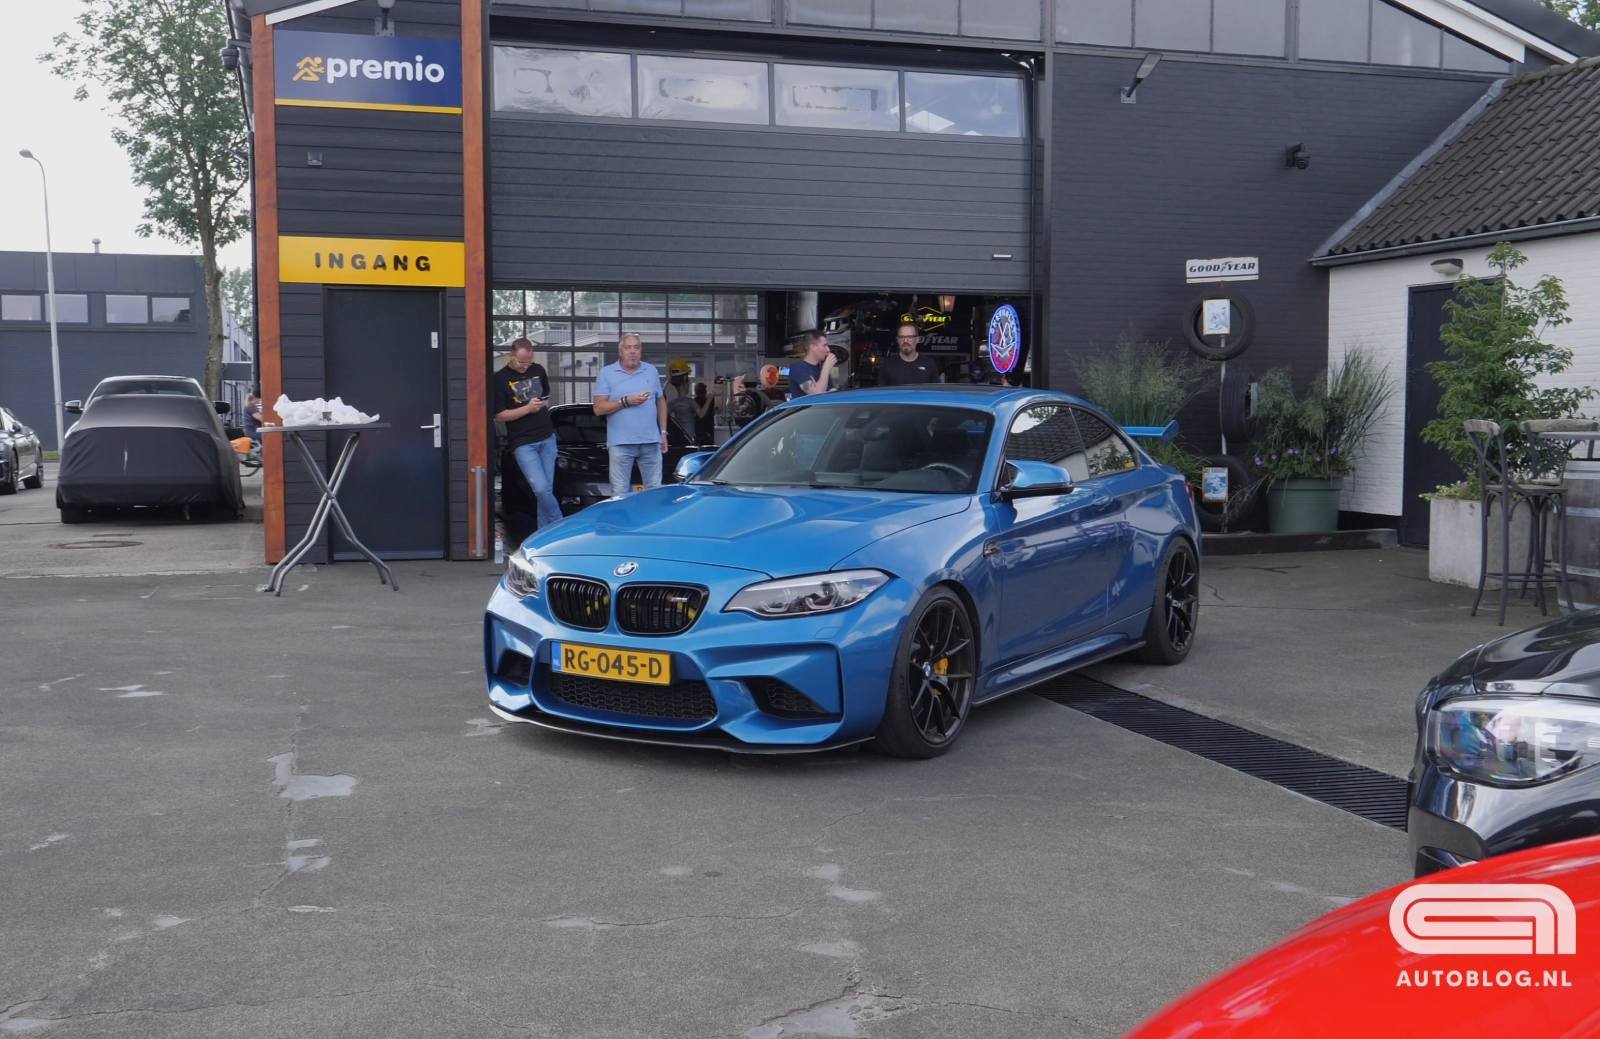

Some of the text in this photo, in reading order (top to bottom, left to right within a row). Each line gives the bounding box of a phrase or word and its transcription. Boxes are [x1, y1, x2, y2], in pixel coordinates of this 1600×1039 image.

[327, 55, 445, 84] premio
[314, 252, 431, 273] INGANG
[1189, 261, 1256, 273] GOODYEAR
[564, 647, 662, 679] RG-045-D
